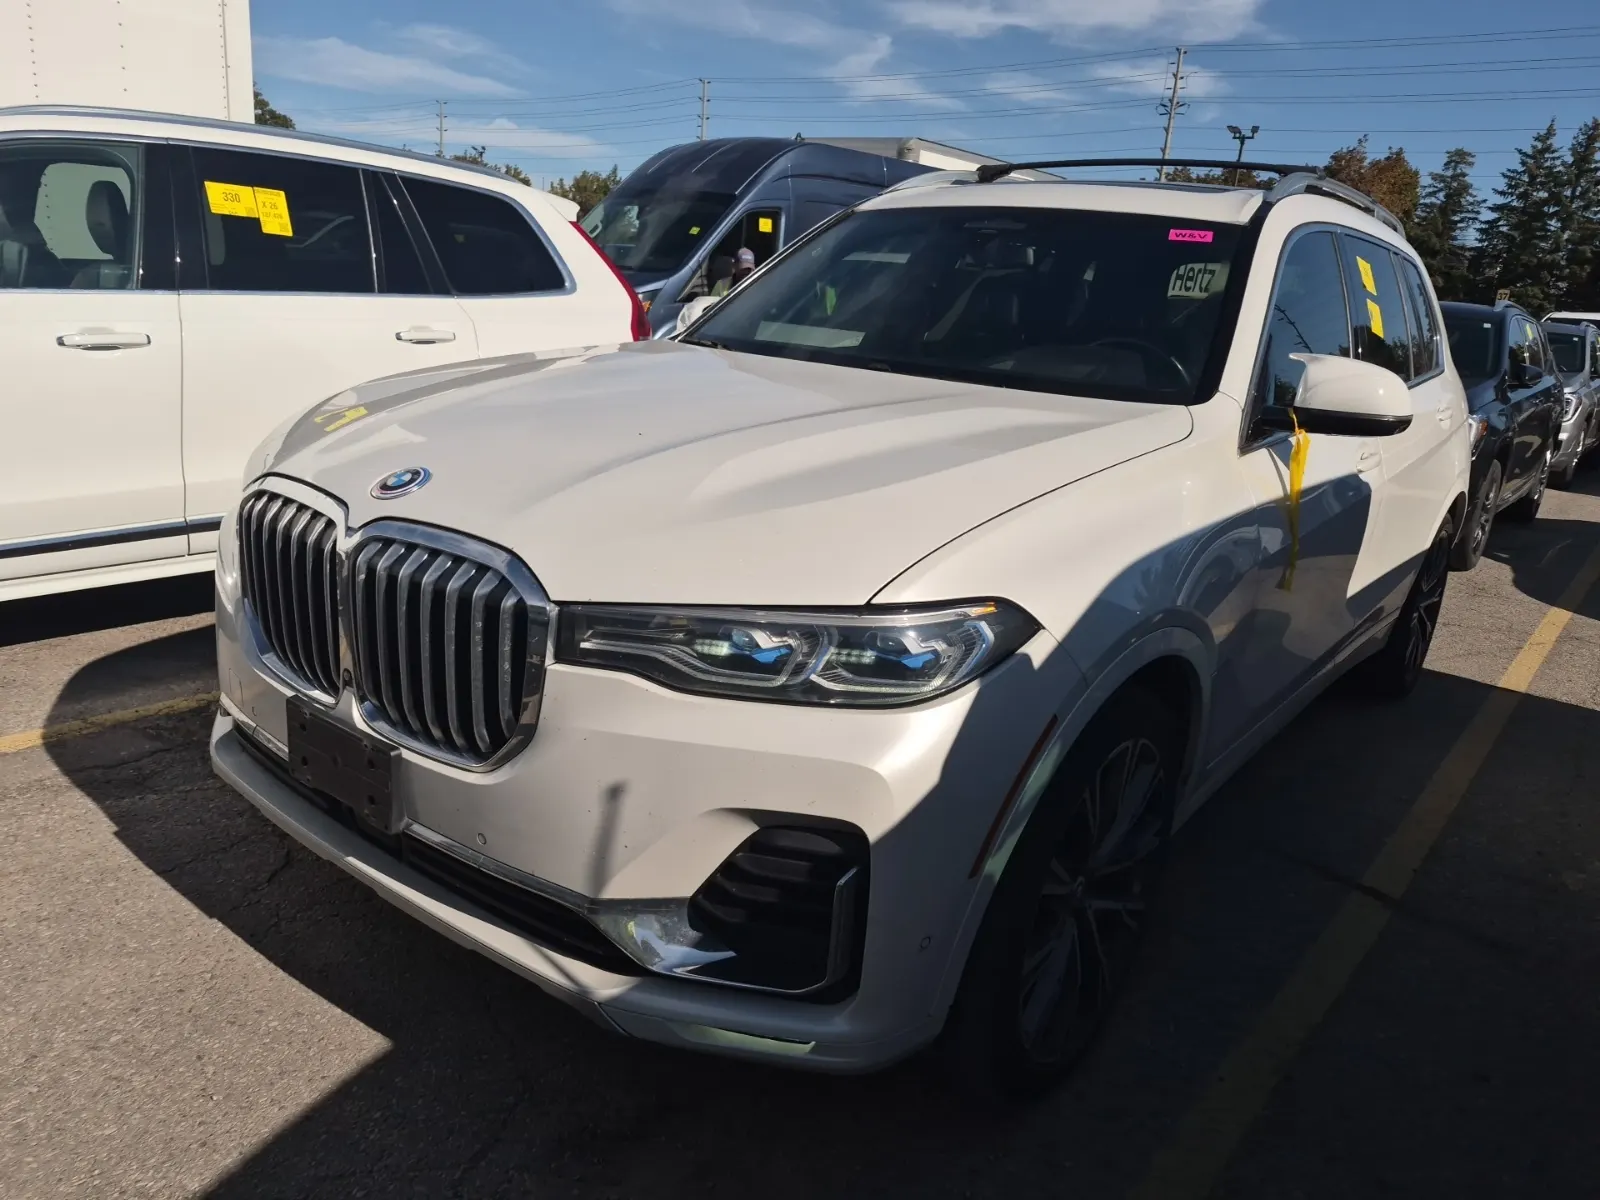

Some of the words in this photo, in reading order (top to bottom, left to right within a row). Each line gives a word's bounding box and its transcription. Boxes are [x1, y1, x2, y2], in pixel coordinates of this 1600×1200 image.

[222, 191, 241, 203] 330
[261, 201, 268, 209] X
[1171, 262, 1217, 294] Hertz
